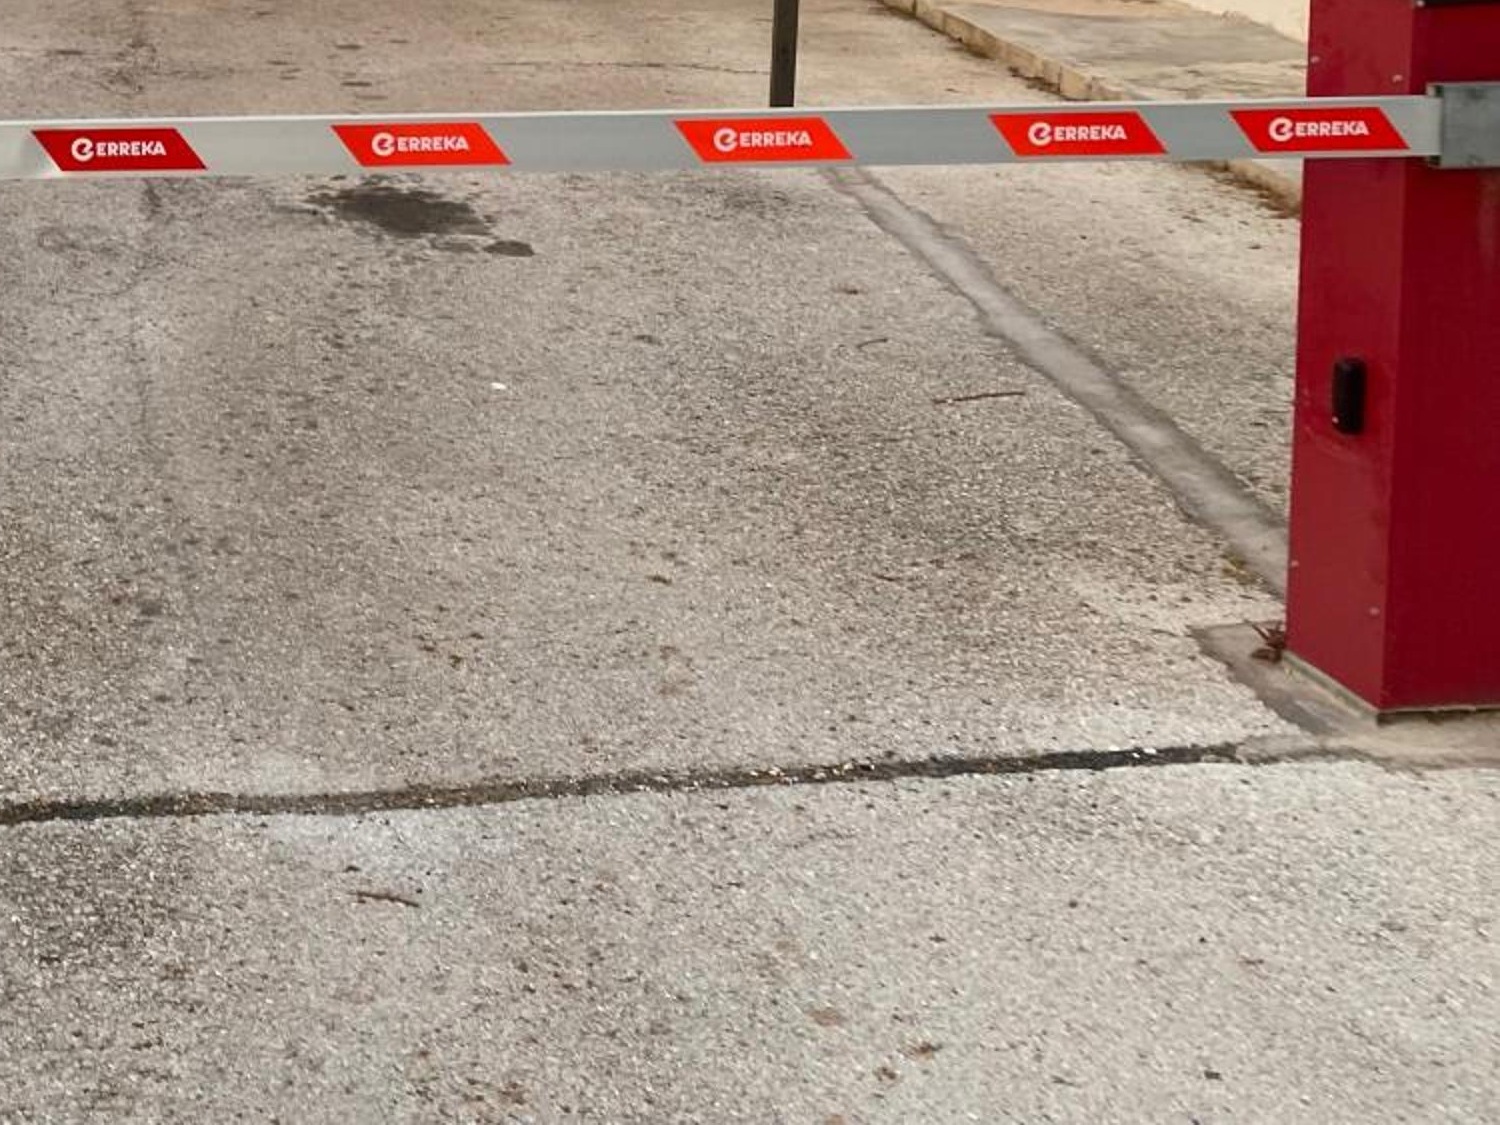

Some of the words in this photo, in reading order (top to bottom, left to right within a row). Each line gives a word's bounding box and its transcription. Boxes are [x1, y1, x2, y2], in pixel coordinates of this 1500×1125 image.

[1053, 124, 1128, 142] ERREKA
[1294, 120, 1370, 138] ERREKA
[396, 135, 470, 153] ERREKA
[738, 130, 813, 148] ERREKA
[95, 140, 168, 158] ERREKA
